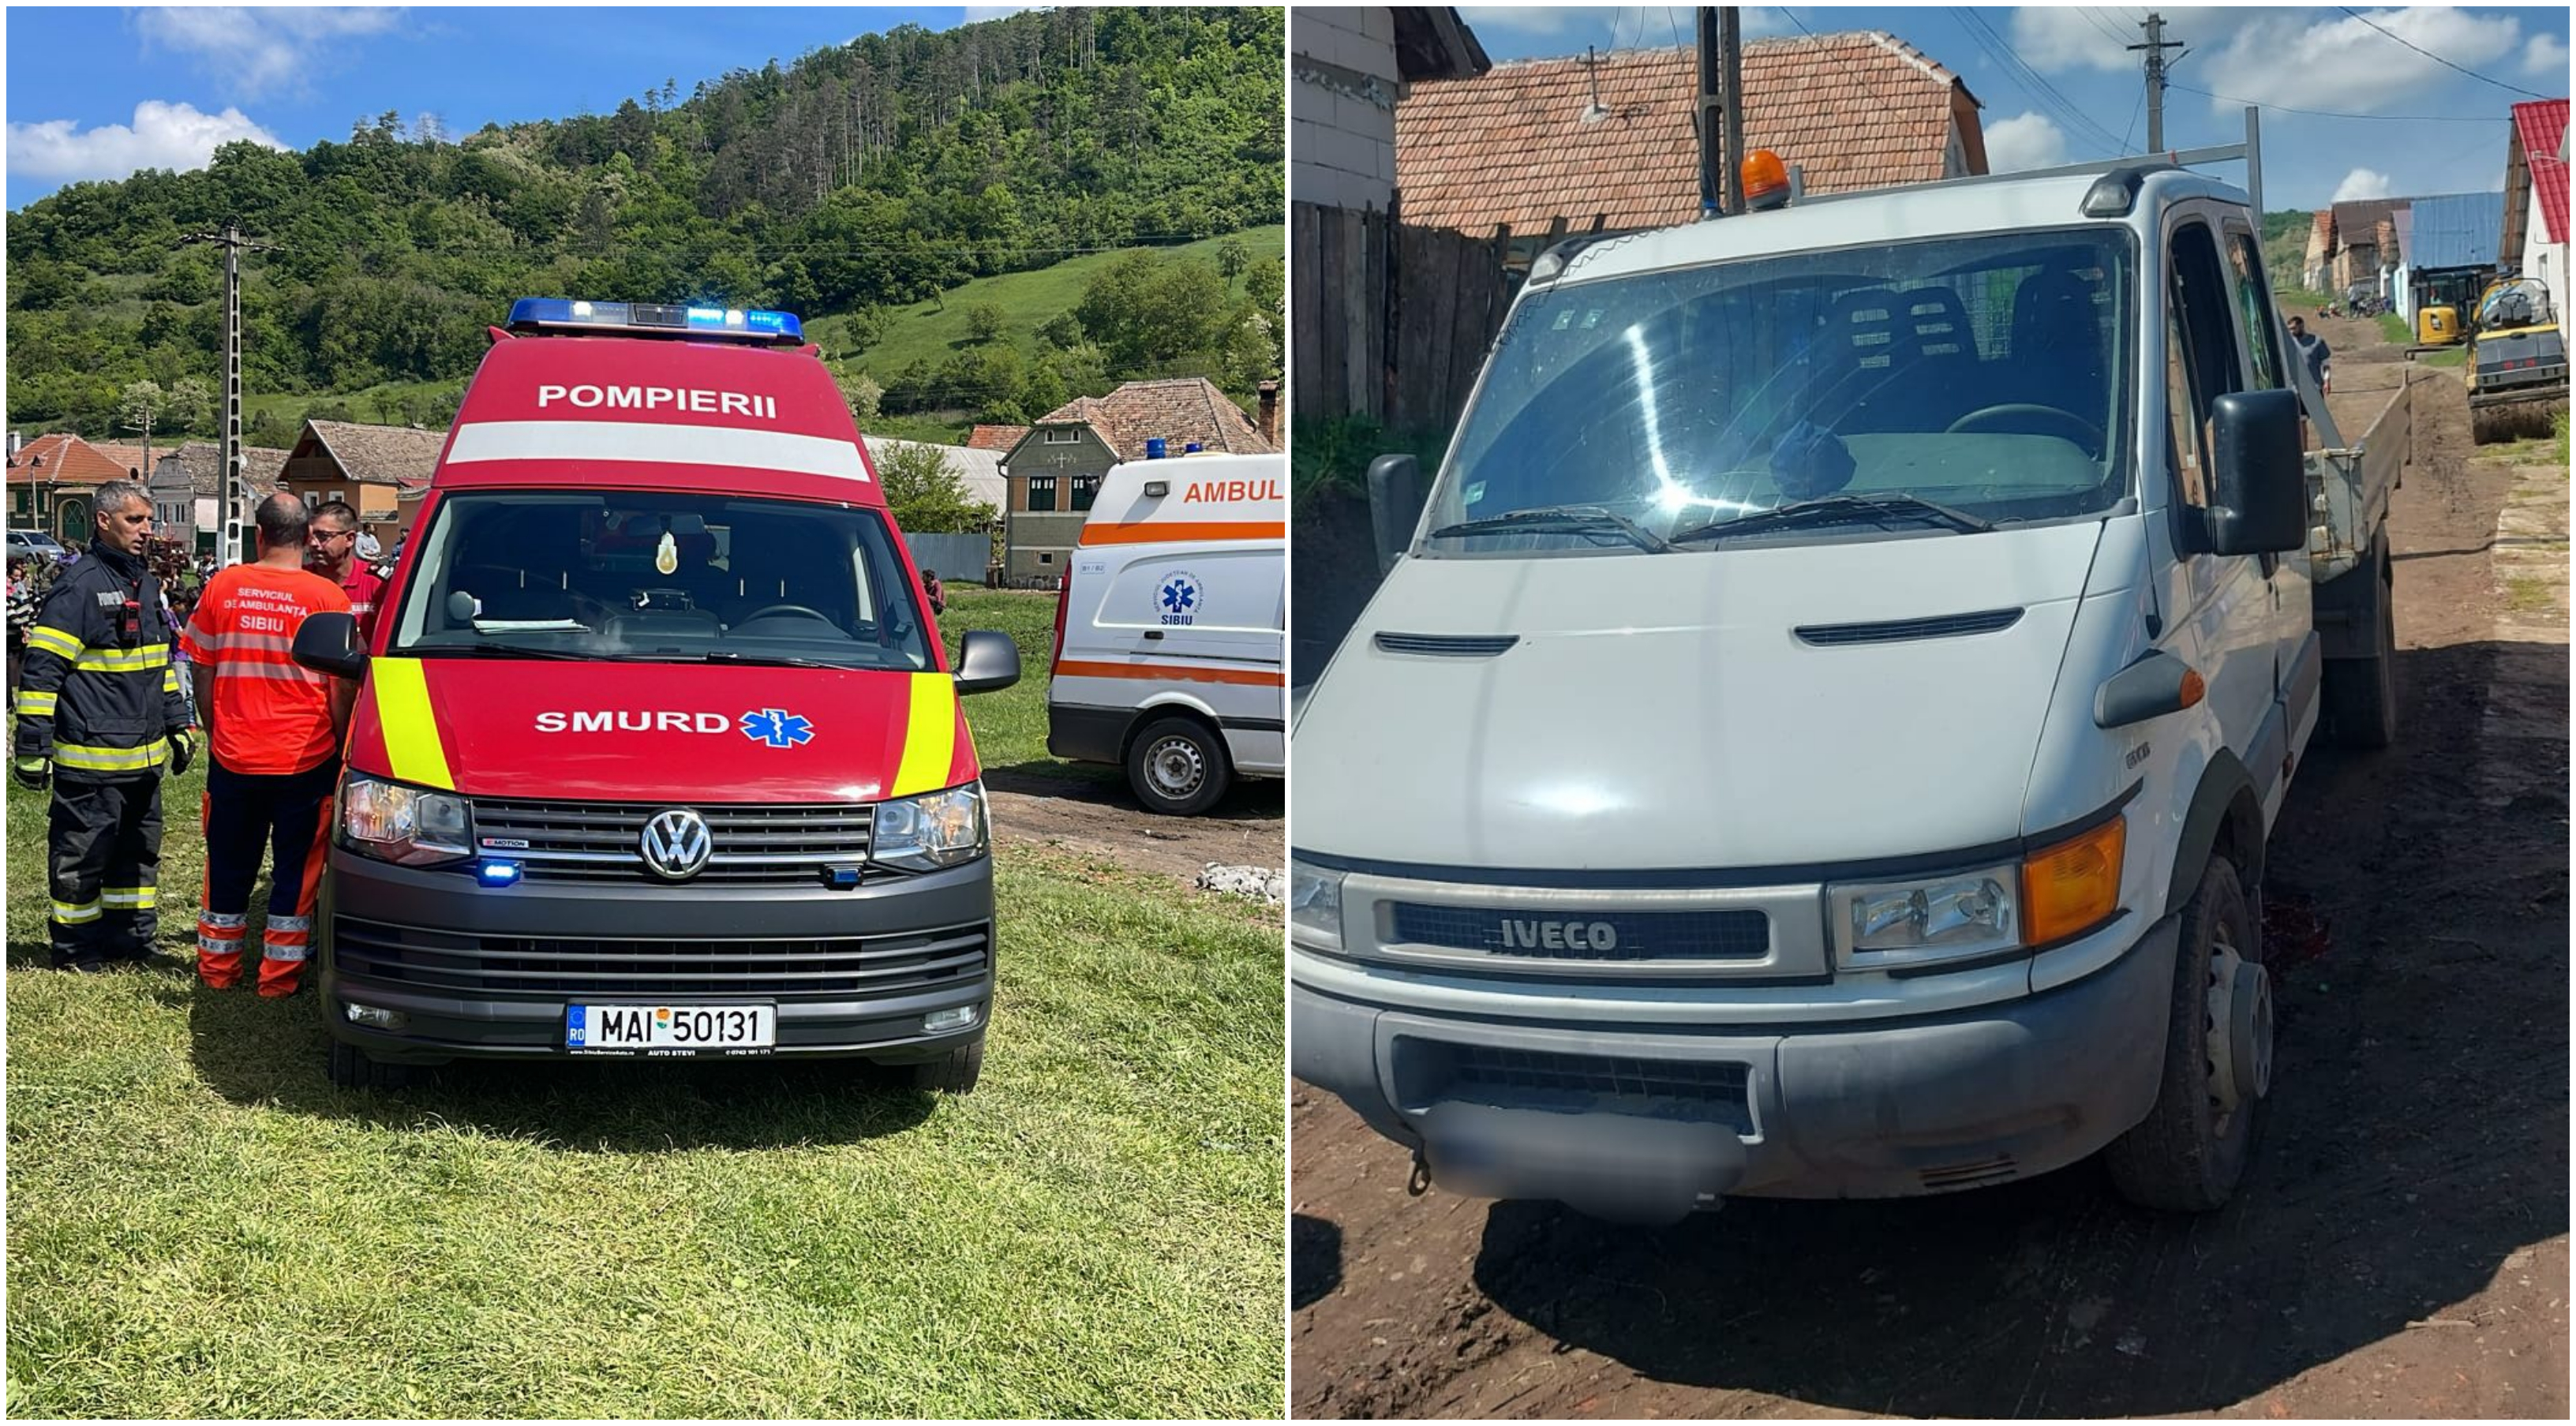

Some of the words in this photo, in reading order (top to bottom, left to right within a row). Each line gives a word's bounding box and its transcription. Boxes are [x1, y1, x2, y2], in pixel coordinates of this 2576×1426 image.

[538, 384, 777, 419] POMPIERII
[1183, 479, 1284, 503] AMBUL
[223, 599, 238, 609] DE
[238, 587, 294, 602] SERVICIUL
[240, 615, 284, 633] SIBIU
[1161, 615, 1193, 625] SIBIU
[534, 711, 730, 733] SMURD
[1501, 919, 1617, 950] IVECO
[570, 1028, 585, 1041] RO
[601, 1011, 652, 1042] MAI
[673, 1011, 758, 1042] 50131
